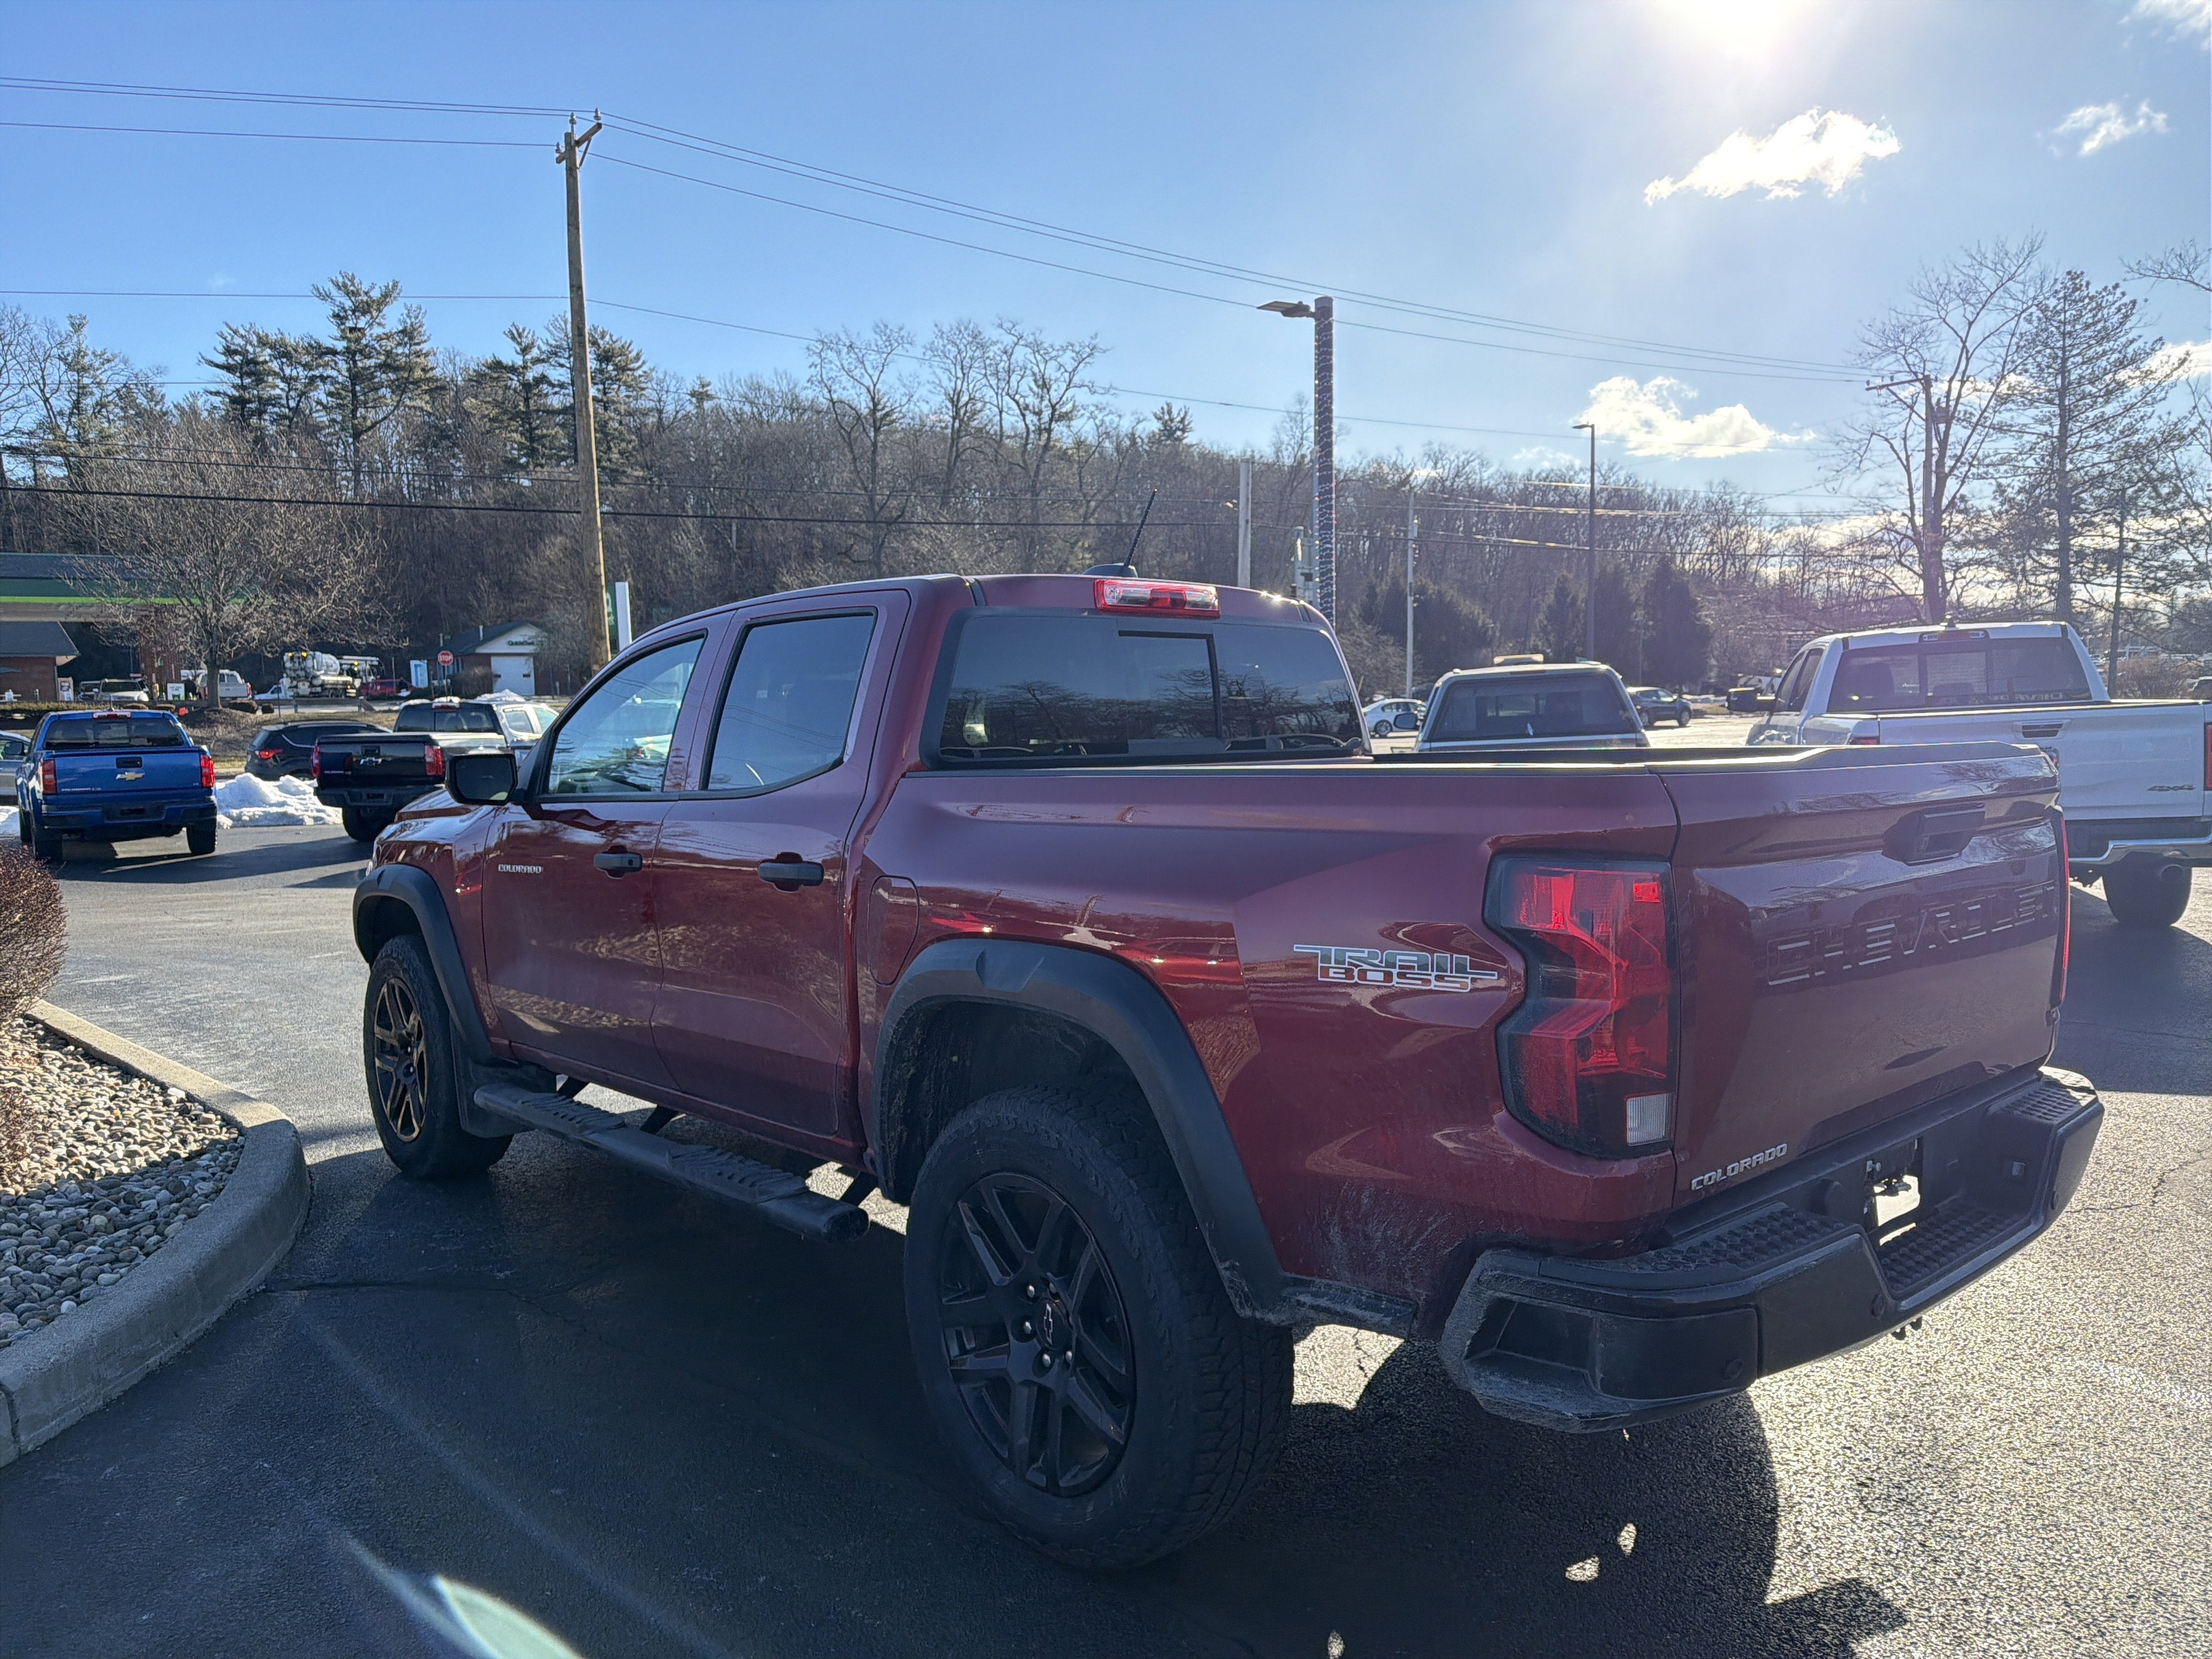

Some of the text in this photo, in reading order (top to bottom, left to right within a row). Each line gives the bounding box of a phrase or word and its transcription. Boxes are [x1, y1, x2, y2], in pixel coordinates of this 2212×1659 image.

[498, 864, 542, 874] COLORADO
[1767, 880, 2056, 986] CHEVROLET
[1294, 944, 1498, 980] TRAIL
[1318, 964, 1471, 992] BOSS
[1691, 1143, 1787, 1190] COLORADO
